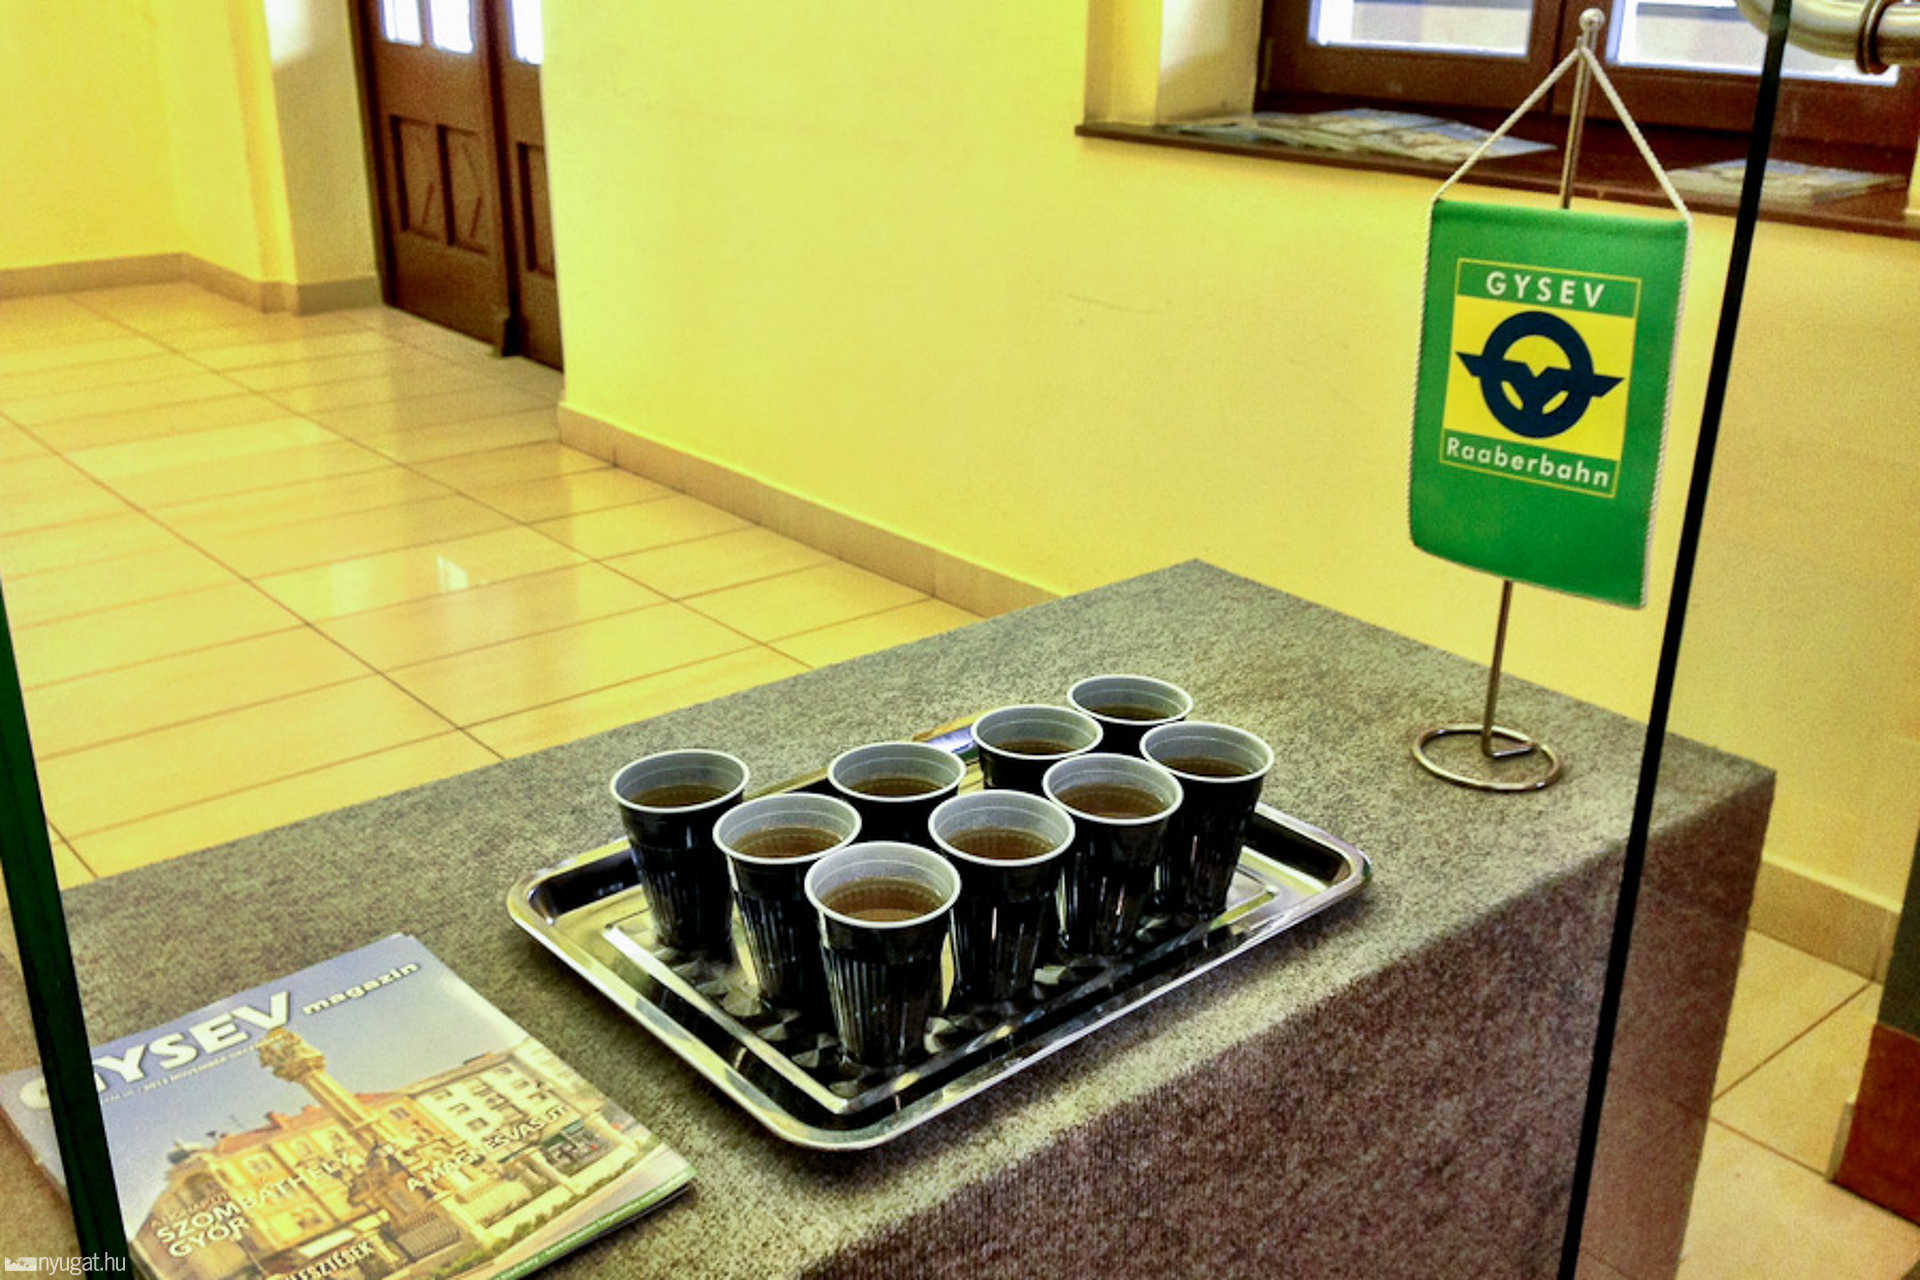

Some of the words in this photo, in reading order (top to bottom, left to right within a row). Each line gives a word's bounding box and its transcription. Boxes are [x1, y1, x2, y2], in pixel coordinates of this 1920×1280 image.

[1486, 271, 1605, 308] GYSEV
[1446, 437, 1610, 488] Raaberbahn
[302, 963, 420, 1015] magazin
